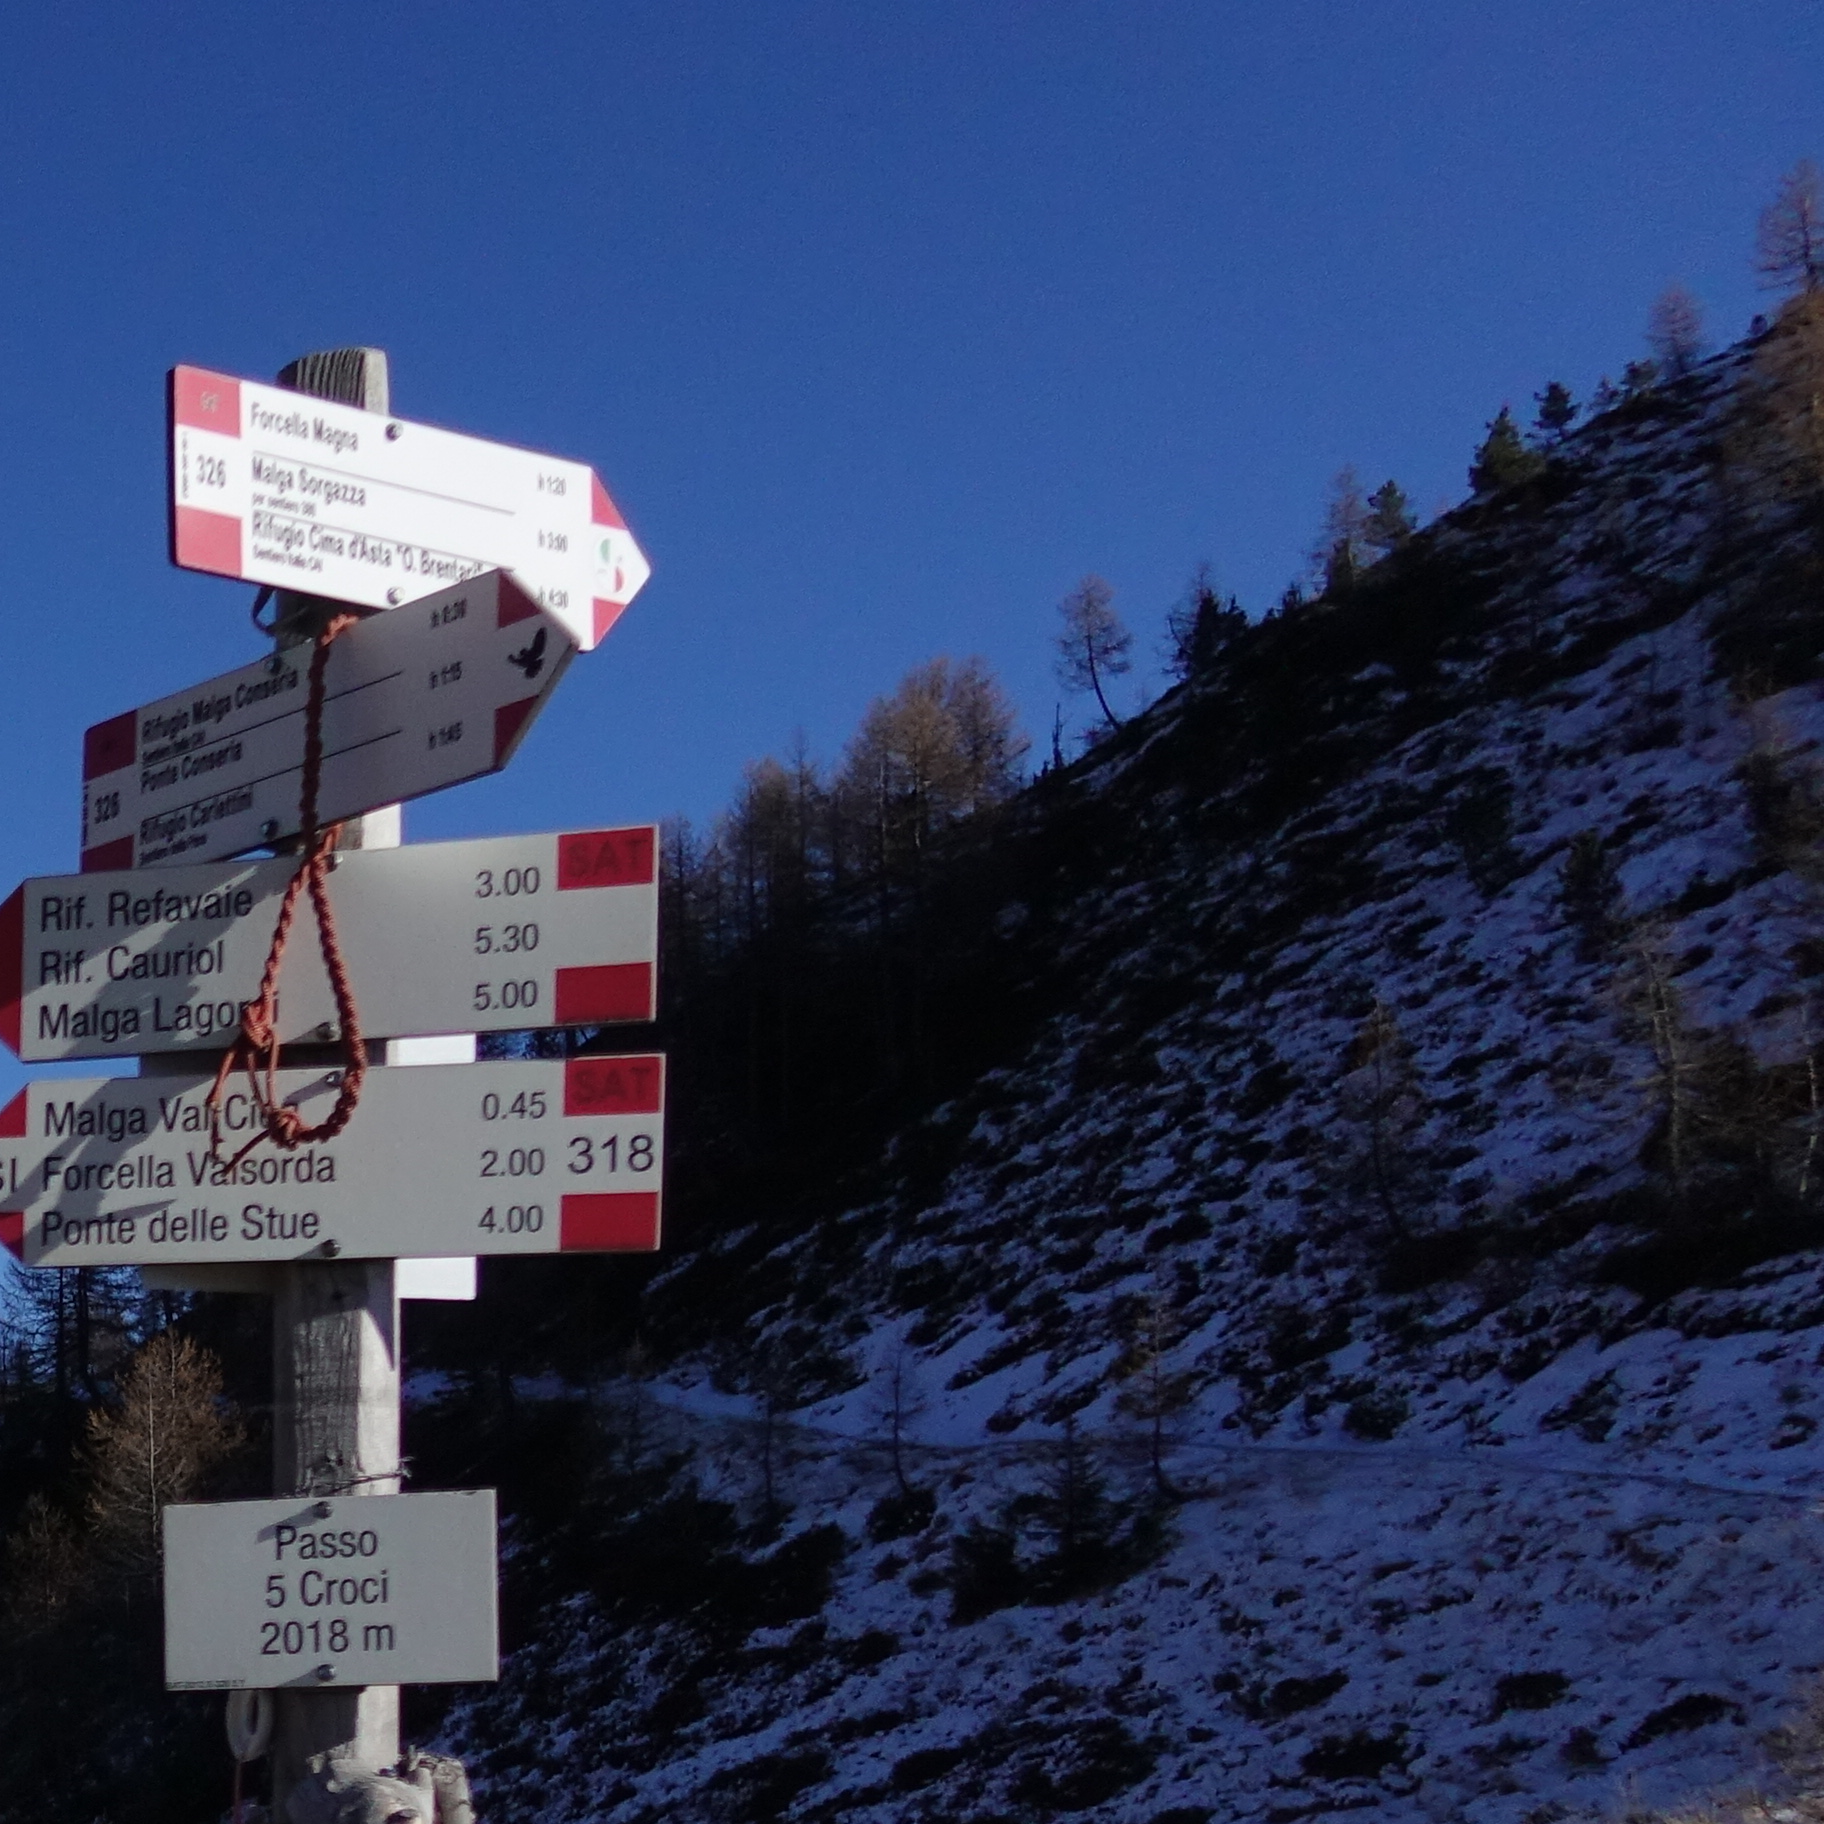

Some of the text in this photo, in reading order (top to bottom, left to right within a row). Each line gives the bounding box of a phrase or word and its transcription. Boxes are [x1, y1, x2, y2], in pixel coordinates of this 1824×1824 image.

[251, 401, 310, 440] Forcella
[313, 416, 359, 455] Magna
[195, 454, 227, 490] 326
[251, 456, 367, 507] Malga Sorgazza
[253, 511, 305, 550] Rifugio
[308, 523, 345, 555] Cima
[348, 533, 393, 567] d'Asta
[141, 708, 190, 745] Rifugio
[192, 695, 232, 724] Malga
[566, 838, 649, 877] SAT
[40, 867, 541, 932] Rif. Refavaie 3.00
[40, 923, 539, 986] Rif. Cauriol 5.30
[38, 979, 538, 1043] Malga Lagori 5.00
[573, 1066, 652, 1105] SAT
[44, 1101, 150, 1142] Malga
[481, 1091, 547, 1121] 0.45
[42, 1147, 545, 1191] Forcella Valsorda 2.00
[567, 1133, 654, 1175] 318
[40, 1203, 544, 1247] Ponte delle Stue 4.00
[274, 1524, 379, 1560] Passo
[264, 1568, 389, 1608] 5 Croci
[260, 1618, 394, 1655] 2018 m
